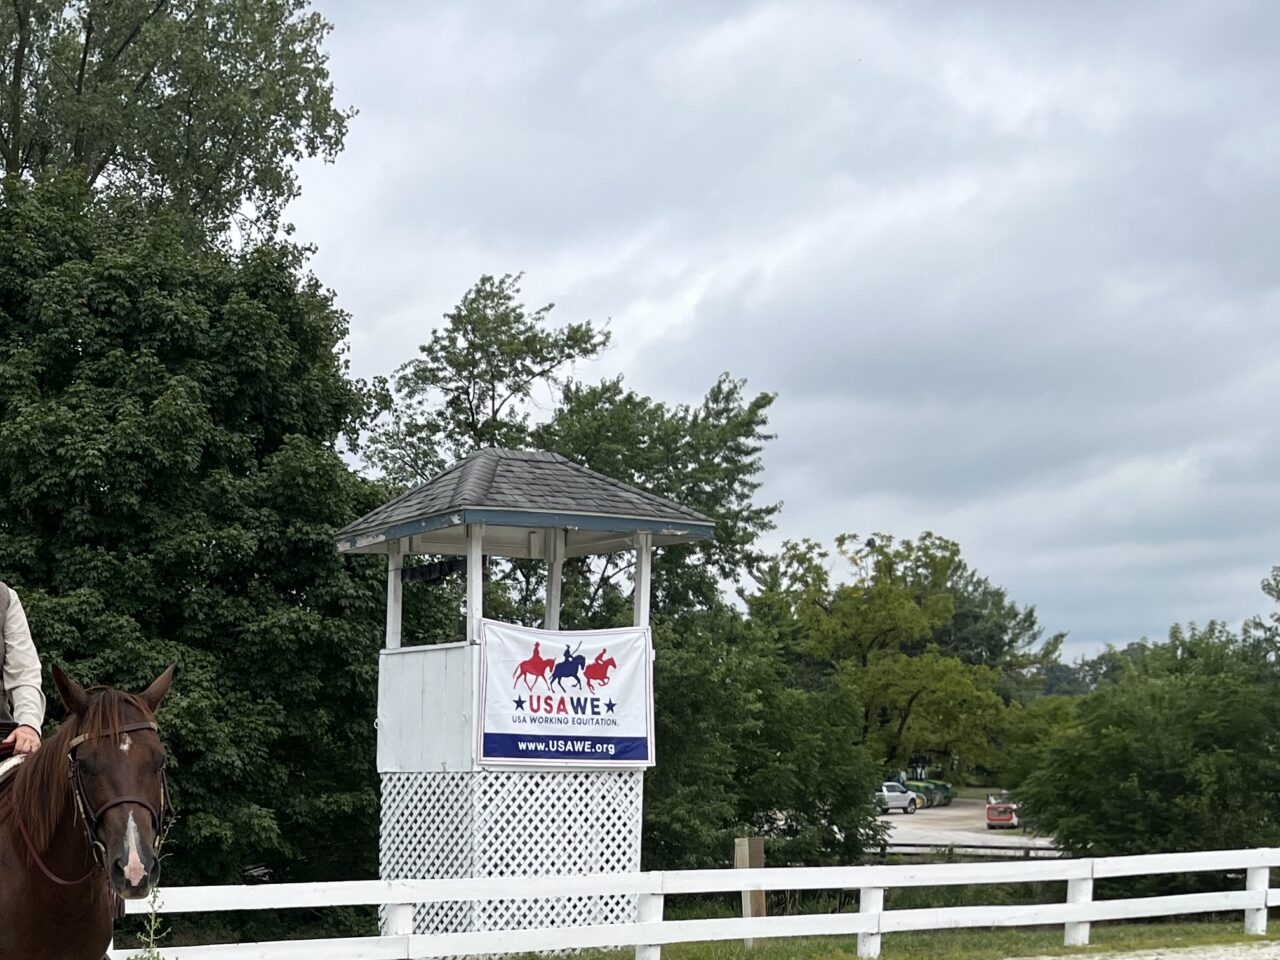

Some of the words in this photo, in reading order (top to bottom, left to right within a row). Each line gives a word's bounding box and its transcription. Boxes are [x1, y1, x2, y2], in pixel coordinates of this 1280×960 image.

[529, 695, 601, 715] USAWE
[512, 715, 527, 724] USA
[530, 716, 569, 725] WORKING
[518, 740, 615, 755] www.USAWE.org
